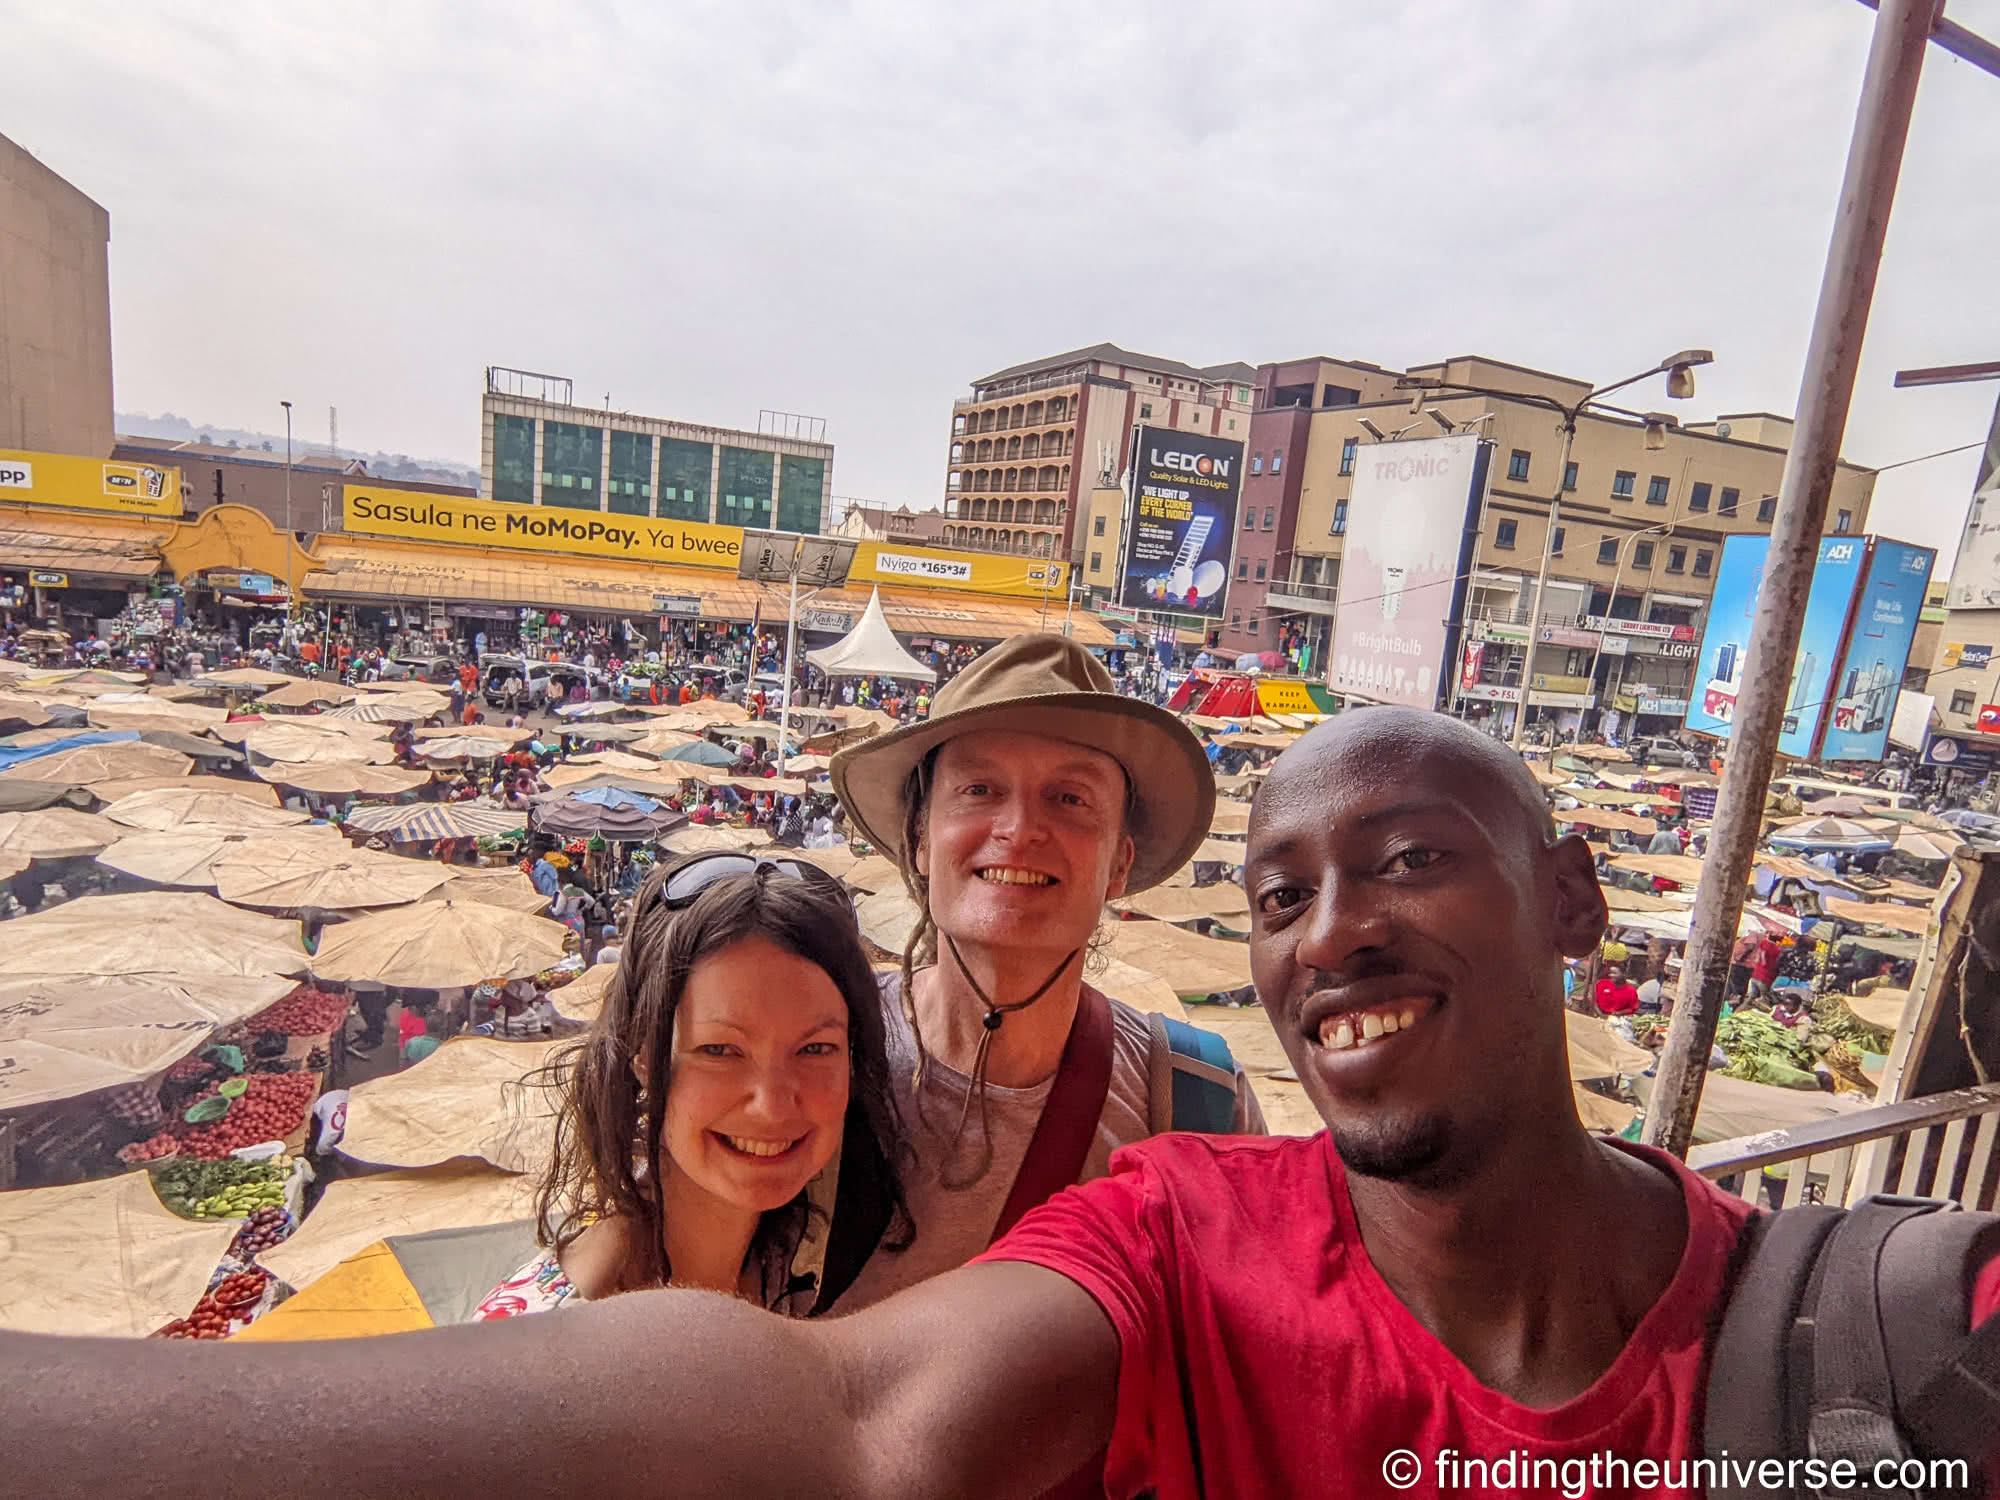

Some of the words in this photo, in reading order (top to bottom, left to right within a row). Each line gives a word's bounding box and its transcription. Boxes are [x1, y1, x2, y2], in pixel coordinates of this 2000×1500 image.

[1150, 448, 1230, 477] LEDON
[1374, 457, 1450, 482] TRONIC
[1149, 471, 1173, 482] Quality
[1173, 474, 1189, 484] Solar
[1196, 477, 1210, 486] LED
[1210, 480, 1230, 490] Lights
[1157, 488, 1179, 499] LIGHT
[1179, 490, 1190, 501] UP
[1141, 495, 1165, 507] EVERY
[1165, 499, 1193, 511] CORNER
[1140, 505, 1151, 516] OF
[1151, 507, 1166, 518] THE
[352, 496, 453, 528] Sasula
[463, 513, 497, 532] ne
[506, 513, 640, 550] MoMoPay.
[647, 528, 674, 549] Ya
[681, 532, 740, 556] bwee
[1827, 544, 1854, 560] ADH
[881, 556, 918, 573] Nyiga
[1351, 631, 1423, 657] #BrightBulb
[1501, 690, 1516, 700] FSL
[1266, 702, 1308, 710] KAMPALA
